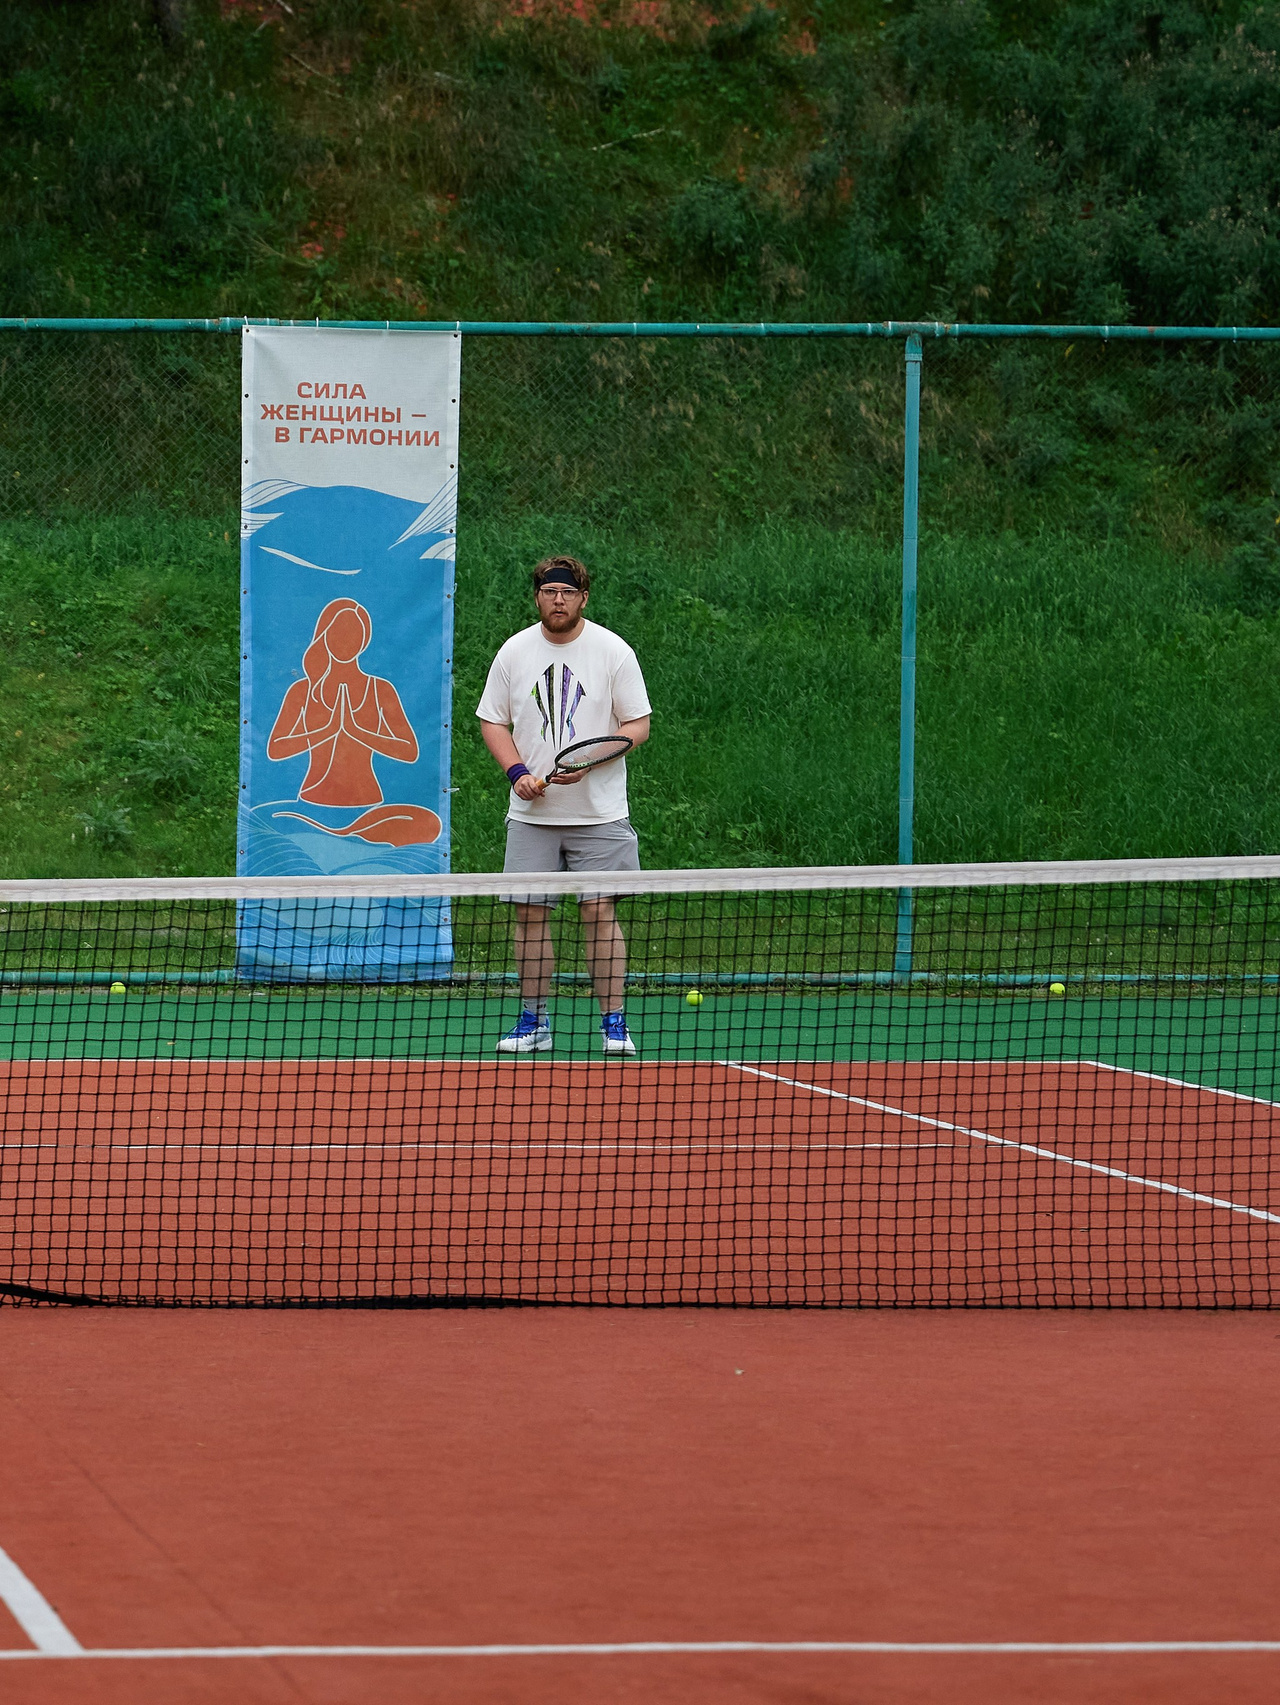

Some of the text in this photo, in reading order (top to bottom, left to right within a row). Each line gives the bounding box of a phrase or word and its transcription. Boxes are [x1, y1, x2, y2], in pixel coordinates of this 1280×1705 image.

[297, 381, 367, 400] СИЛА
[260, 403, 402, 425] ЖЕНЩИНЫ
[275, 426, 440, 447] В ГАРМОНИИ
